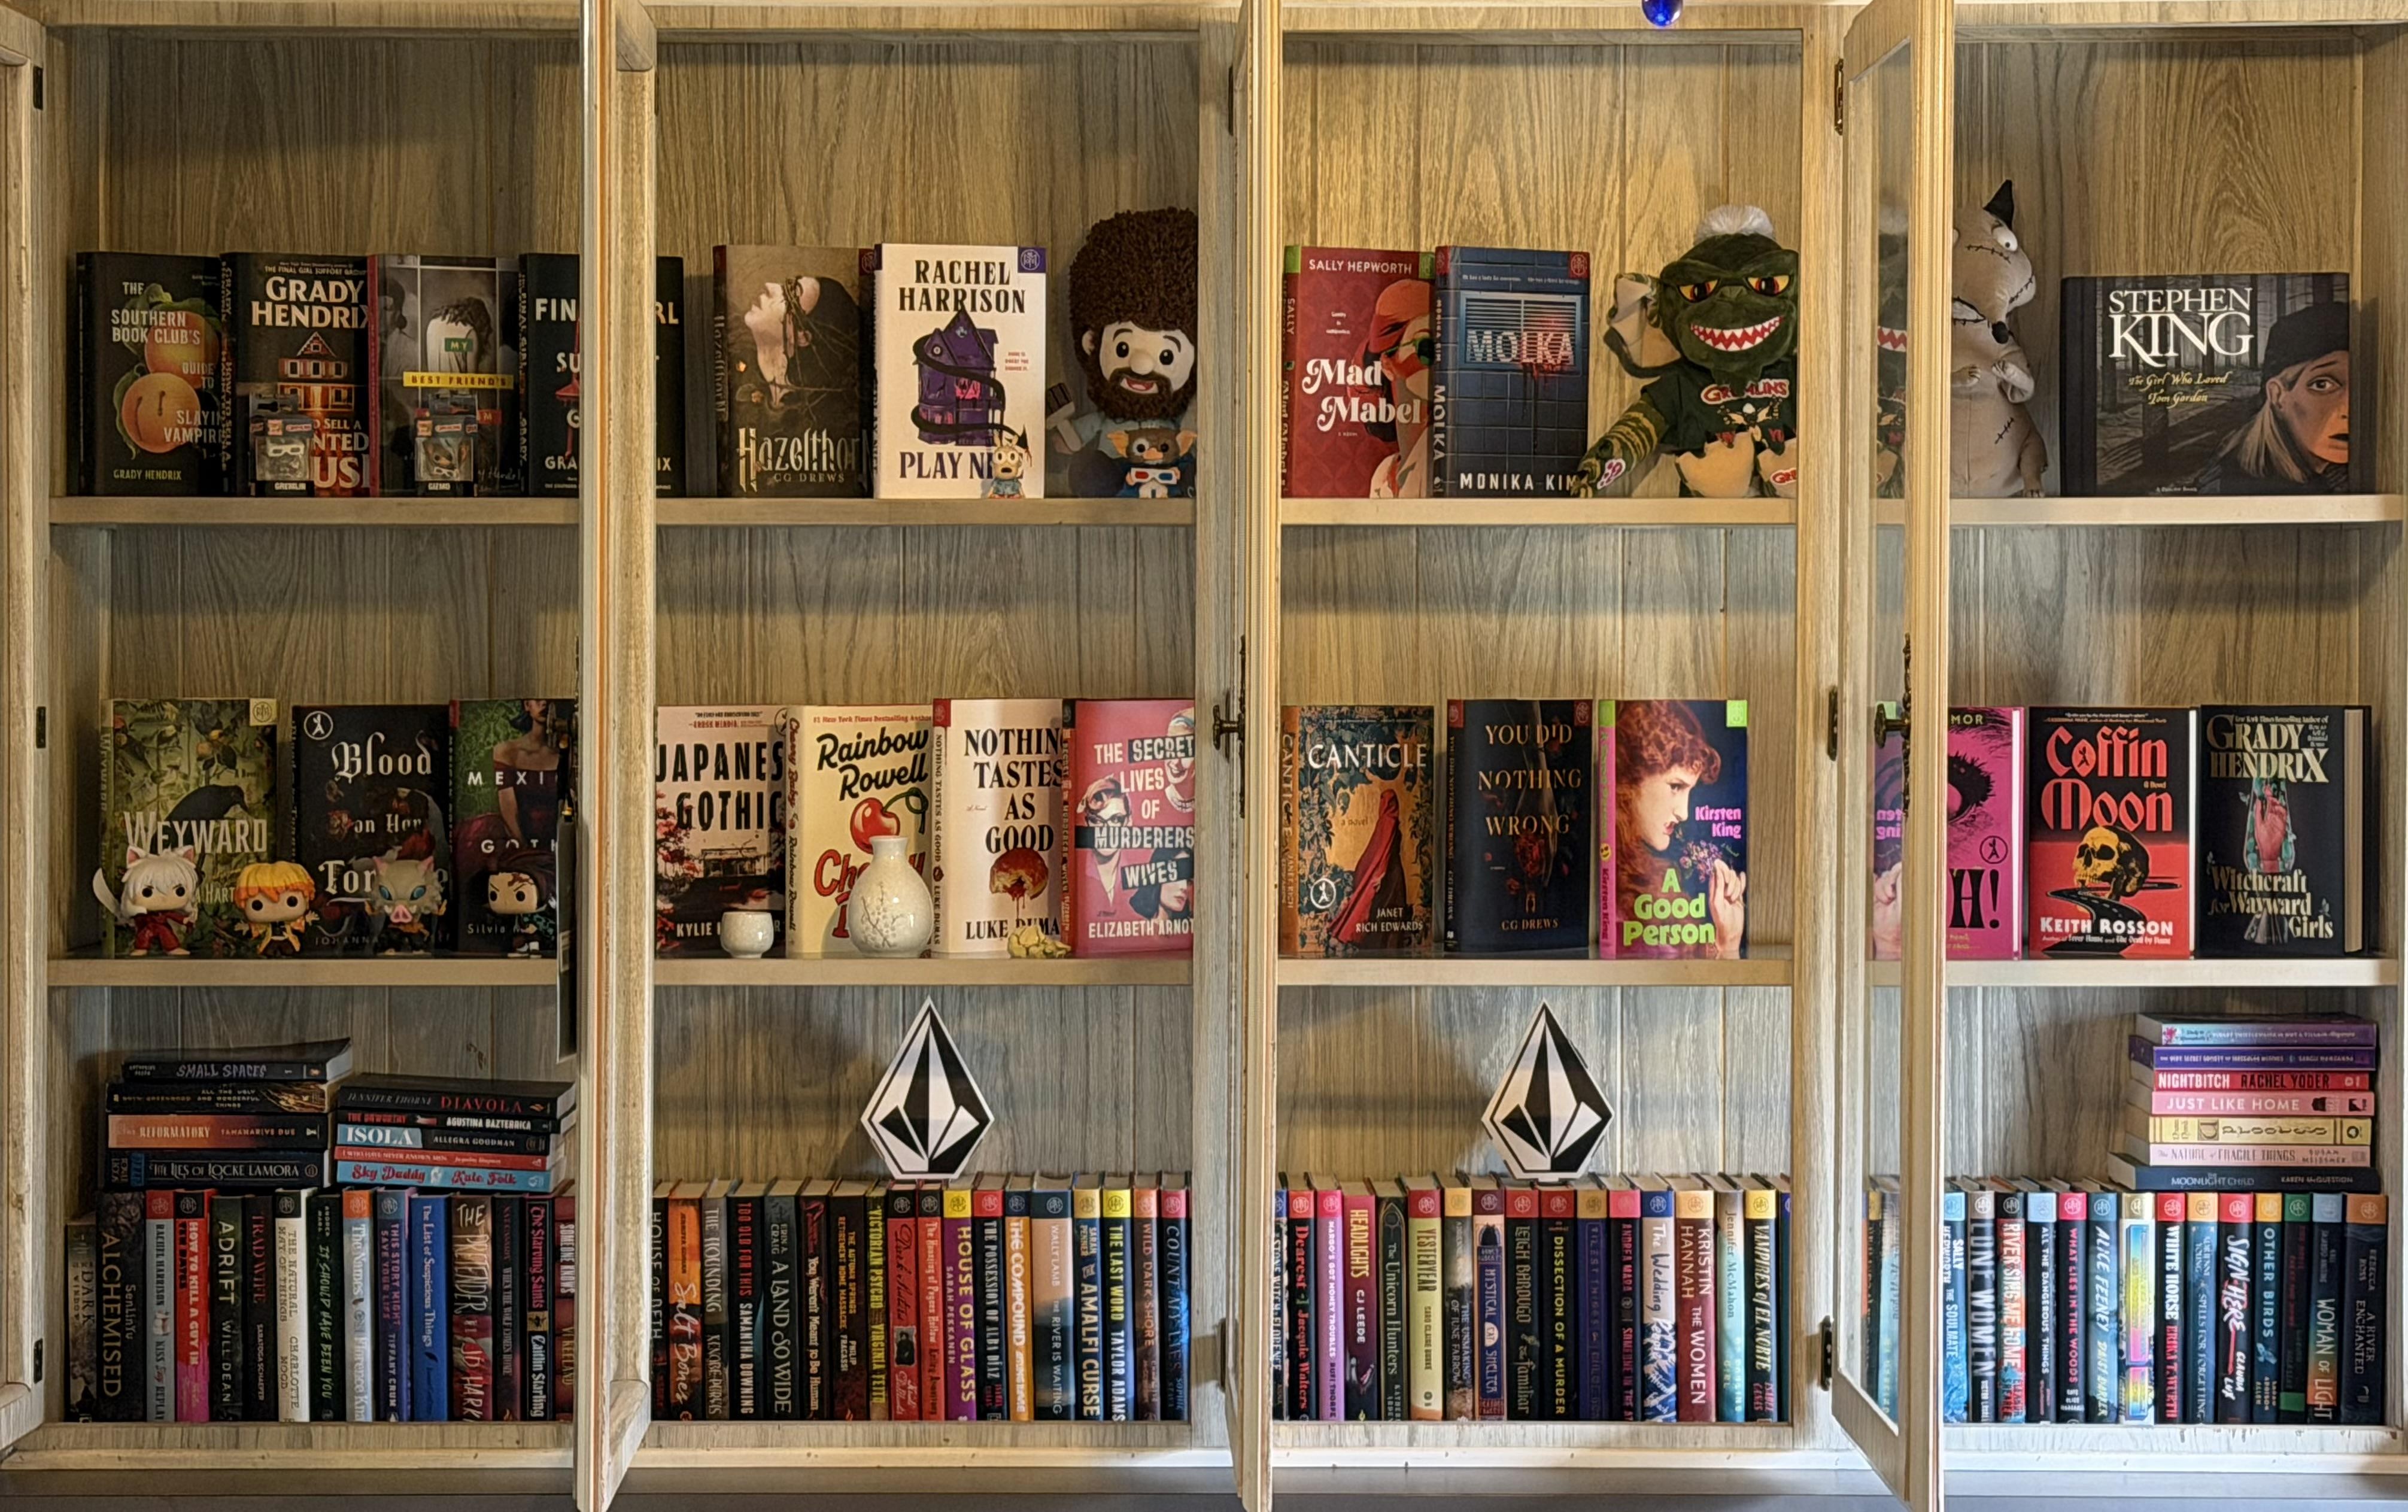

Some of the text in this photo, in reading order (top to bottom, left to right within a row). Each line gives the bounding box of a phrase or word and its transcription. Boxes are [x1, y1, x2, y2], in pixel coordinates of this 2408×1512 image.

[915, 260, 1010, 285] RACHEL
[1309, 259, 1412, 274] SALLY HEPWORTH
[123, 282, 144, 295] THE
[266, 276, 364, 303] GRADY
[898, 287, 1025, 313] HARRISON
[2109, 287, 2253, 314] STEPHEN
[111, 309, 186, 326] SOUTHERN
[112, 327, 201, 345] BOOK CLUB'S
[451, 340, 469, 350] MY
[1466, 329, 1574, 365] MOLKA
[2109, 311, 2254, 368] KING
[182, 362, 214, 376] GUIDE
[202, 376, 214, 388] TO
[411, 375, 506, 386] BEST FRIEND'S
[1302, 359, 1382, 394] Mad
[2128, 371, 2233, 392] The Girl Who Loved
[2148, 388, 2208, 409] Tom Gordon
[1317, 396, 1421, 432] Mabel
[1433, 384, 1446, 460] MOLKA
[113, 469, 182, 480] GRADY HENDRIX
[775, 473, 845, 483] CG DREWS
[900, 451, 962, 479] PLAY
[1460, 473, 1534, 491] MONIKA
[1485, 724, 1573, 745] YOU DID
[2207, 714, 2305, 754] GRADY
[332, 732, 432, 784] Blood
[656, 742, 783, 782] JAPANES
[816, 727, 929, 771] Rainbow
[1094, 735, 1194, 764] THE SECRET
[1308, 743, 1427, 769] CANTICLE
[2046, 725, 2168, 778] Coffin
[839, 753, 928, 801] Rowell
[974, 760, 1063, 789] TASTES
[1478, 768, 1582, 791] NOTHING
[2210, 748, 2330, 784] HENDRIX
[1120, 768, 1164, 793] LIVES
[934, 781, 943, 816] TASTES
[1004, 793, 1036, 821] AS
[1141, 799, 1160, 819] OF
[2041, 778, 2173, 833] Moon
[354, 813, 423, 833] on Her
[934, 819, 942, 831] AS
[1485, 815, 1570, 836] WRONG
[1695, 806, 1741, 821] Kirsten
[985, 824, 1054, 854] GOOD
[1712, 823, 1741, 839] King
[934, 834, 942, 862] GOOD
[1125, 861, 1178, 888] WIVES
[1662, 868, 1681, 893] A
[2210, 866, 2307, 892] Witchcraft
[933, 885, 942, 909] LUKE
[1634, 893, 1706, 919] Good
[2229, 891, 2312, 916] Wayward
[1377, 907, 1403, 919] JANET
[1501, 919, 1559, 930] CG DREWS
[2040, 917, 2173, 936] KEITH ROSSON
[676, 921, 713, 937] KYLIE
[965, 919, 1009, 940] LUKE
[1089, 921, 1155, 938] ELIZABETH
[1356, 921, 1423, 933] RICH EDWARDS
[1623, 921, 1715, 946] Person
[2288, 915, 2333, 939] Girls
[176, 1064, 267, 1078] SMALL SPACES
[2158, 1073, 2330, 1089] NIGHTBITCH RACHEL YODER
[441, 1096, 523, 1114] DIAVOLA
[2166, 1098, 2300, 1112] JUST LIKE HOME
[347, 1126, 413, 1146] ISOLA
[218, 1221, 235, 1304] ADRIFT
[1417, 1229, 1437, 1291] YESTERYEAR
[1680, 1225, 1694, 1298] HANNAH
[1698, 1228, 1711, 1295] KRISTIN
[1010, 1220, 1025, 1346] THE COMPOUND
[1350, 1210, 1369, 1343] HEADLIGHTS CJ LEEDE
[1554, 1237, 1564, 1316] DISSECTION
[2095, 1226, 2110, 1332] ALICE FEENEY
[2263, 1228, 2275, 1337] OTHER BIRDS
[1753, 1225, 1771, 1372] VAMPIRES of EL NORTE
[102, 1232, 122, 1396] ALCHEMISED
[958, 1226, 976, 1401] HOUSE OF GLASS
[1110, 1225, 1126, 1421] THE LAST WORD TAYLOR ADAMS
[1386, 1262, 1401, 1374] Unicorn Hunters
[771, 1261, 791, 1413] A LAND SO WIDE
[947, 1306, 955, 1364] PEKKANEN
[1554, 1322, 1564, 1340] OF
[739, 1303, 754, 1413] SAMANTHA DOWNING
[1080, 1283, 1100, 1416] AMALFI CURSE
[1690, 1305, 1705, 1404] THE WOMEN
[2040, 1337, 2049, 1374] THINGS
[2313, 1299, 2336, 1419] WOMAN OF LIGHT
[530, 1335, 546, 1417] Caitlin Starling
[1555, 1358, 1565, 1414] MURDER
